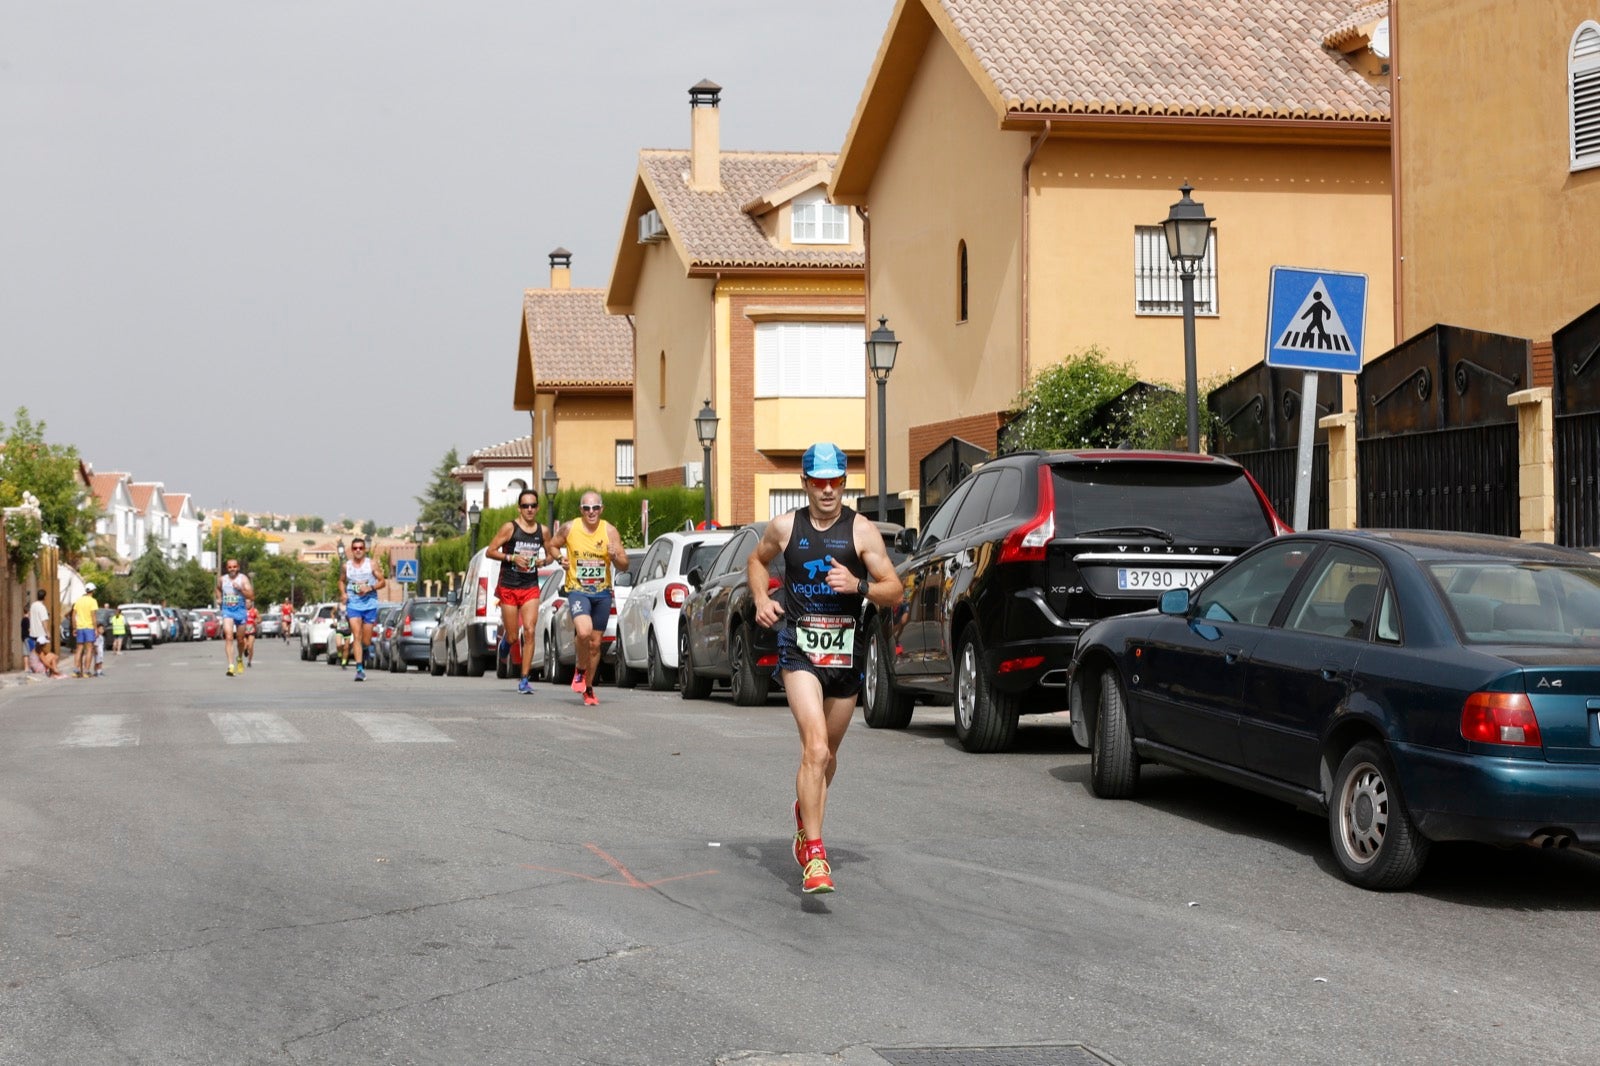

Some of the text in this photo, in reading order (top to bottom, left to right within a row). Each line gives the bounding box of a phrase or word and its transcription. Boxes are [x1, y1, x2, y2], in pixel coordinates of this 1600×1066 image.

[1117, 545, 1220, 554] VOLVO
[581, 567, 601, 577] 223
[1130, 571, 1172, 587] 3790
[792, 582, 838, 598] vegab
[806, 630, 845, 650] 904
[1536, 676, 1563, 688] A4
